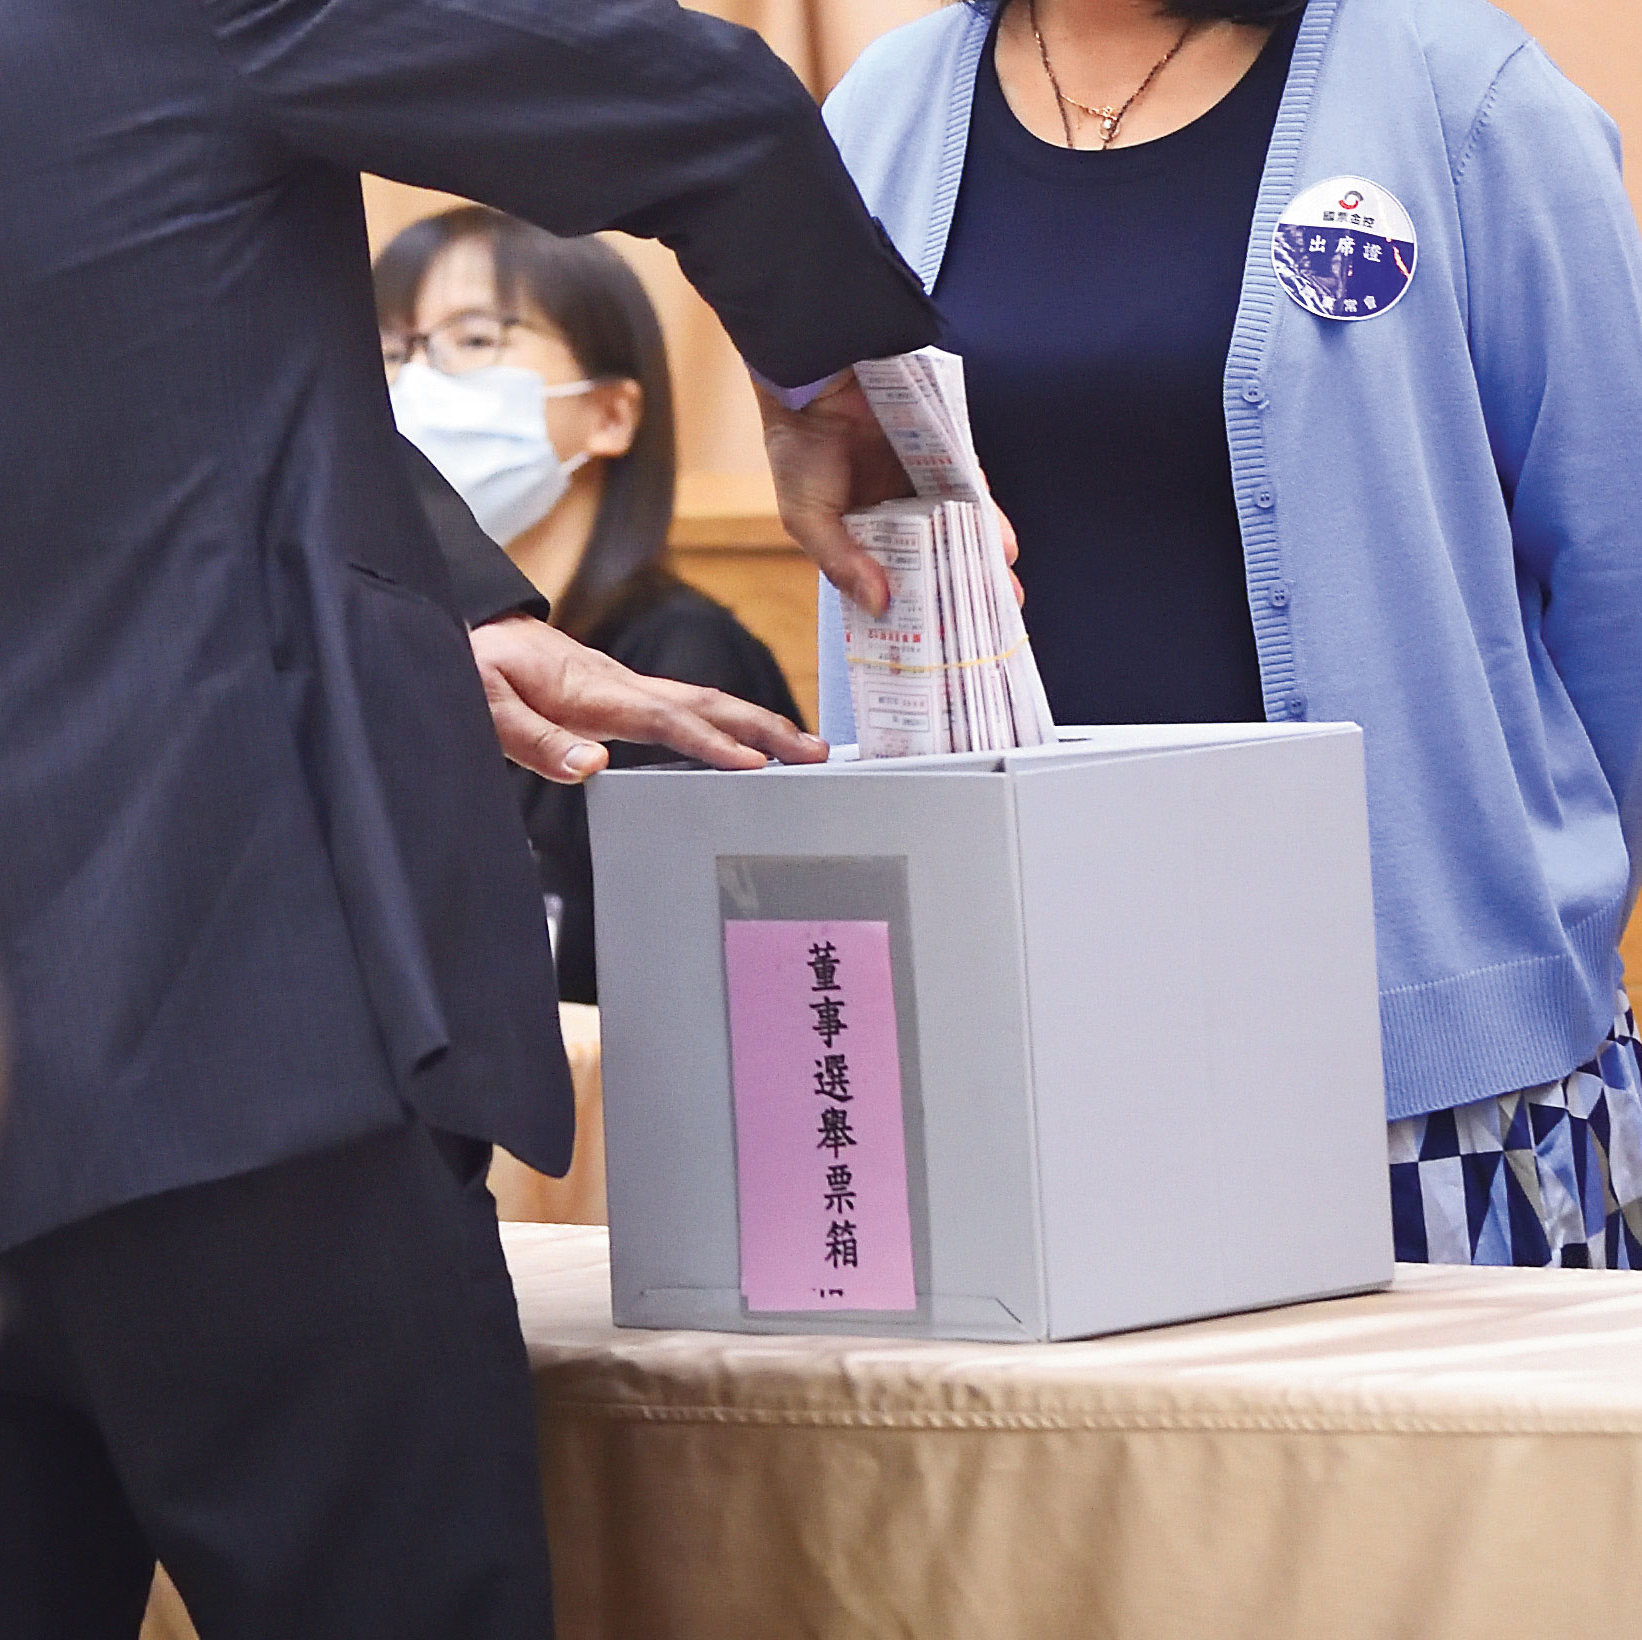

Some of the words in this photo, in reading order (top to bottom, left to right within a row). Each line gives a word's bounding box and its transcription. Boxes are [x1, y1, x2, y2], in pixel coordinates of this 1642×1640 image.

[1308, 234, 1383, 263] 出席證
[806, 940, 859, 1269] 董事選舉票箱
